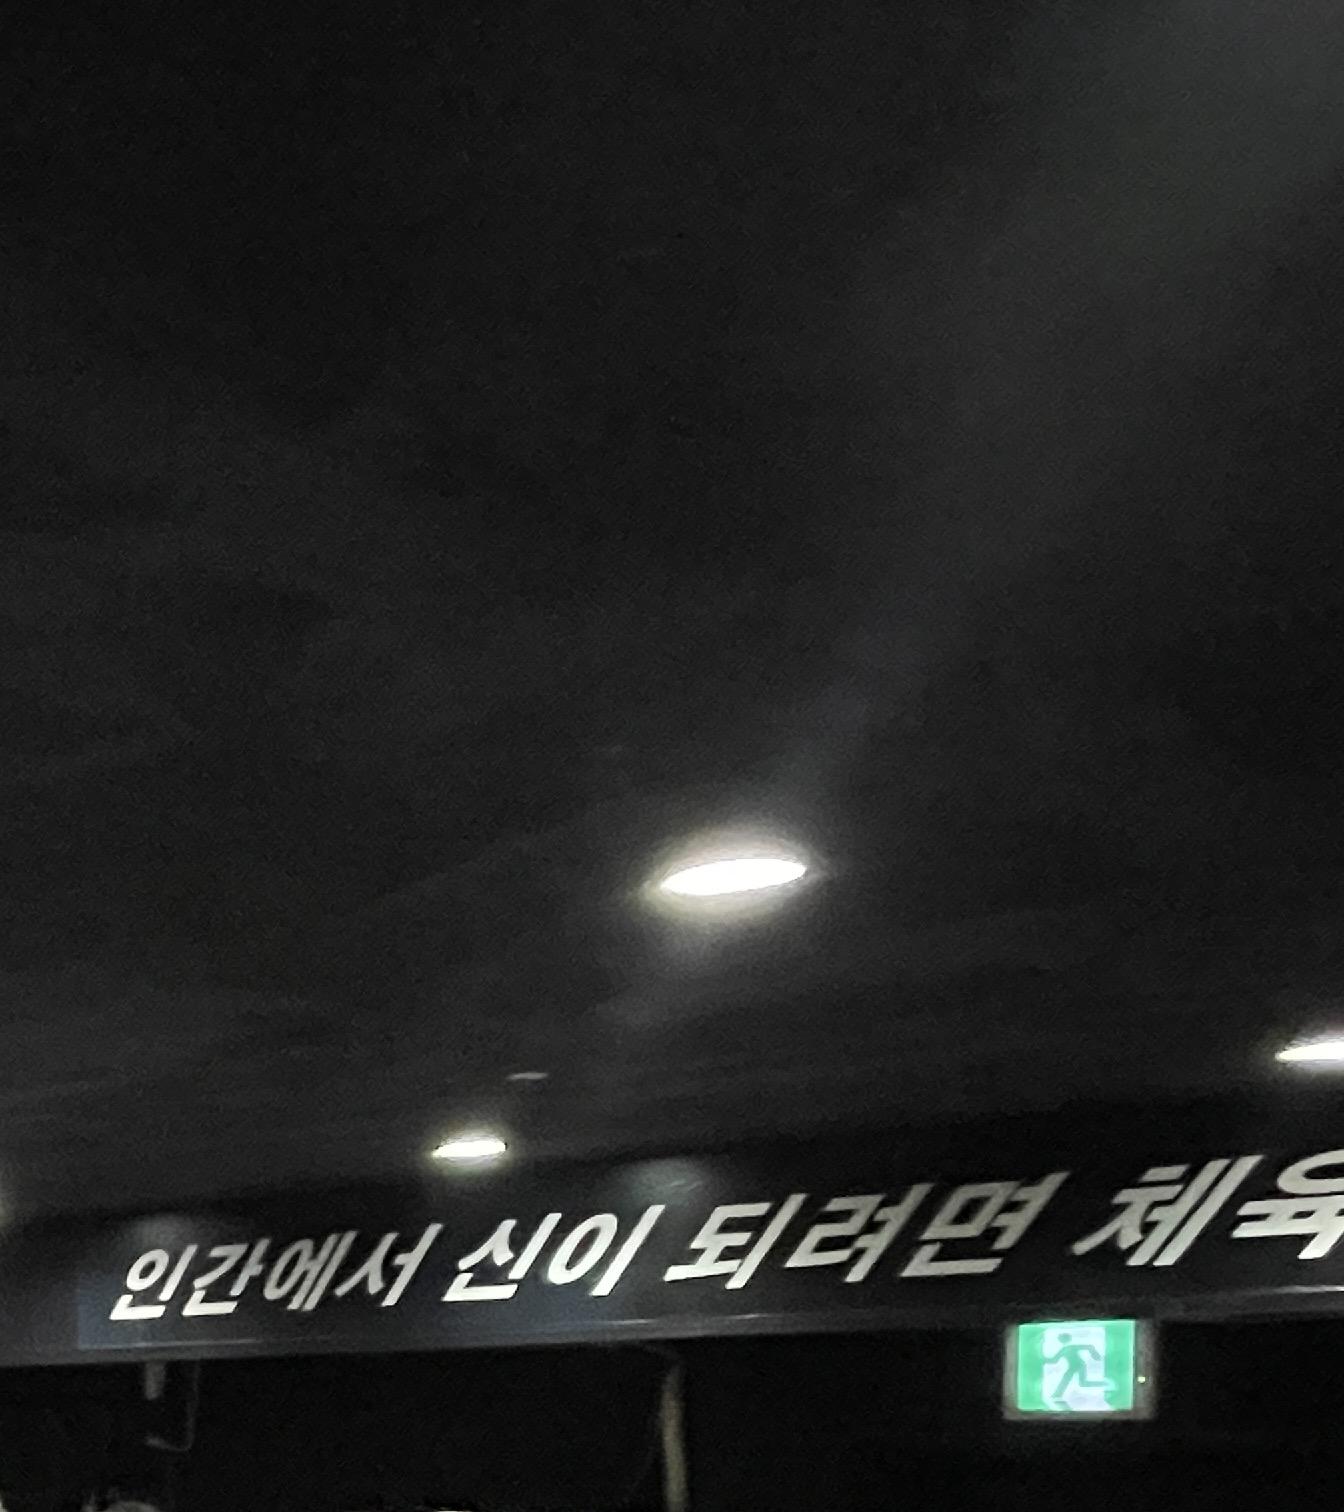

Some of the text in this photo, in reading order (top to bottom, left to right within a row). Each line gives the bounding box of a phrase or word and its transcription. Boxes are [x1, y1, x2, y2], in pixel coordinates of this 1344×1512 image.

[109, 1223, 443, 1321] 인간에서
[441, 1203, 667, 1302] 신이
[662, 1171, 1072, 1290] 되려면
